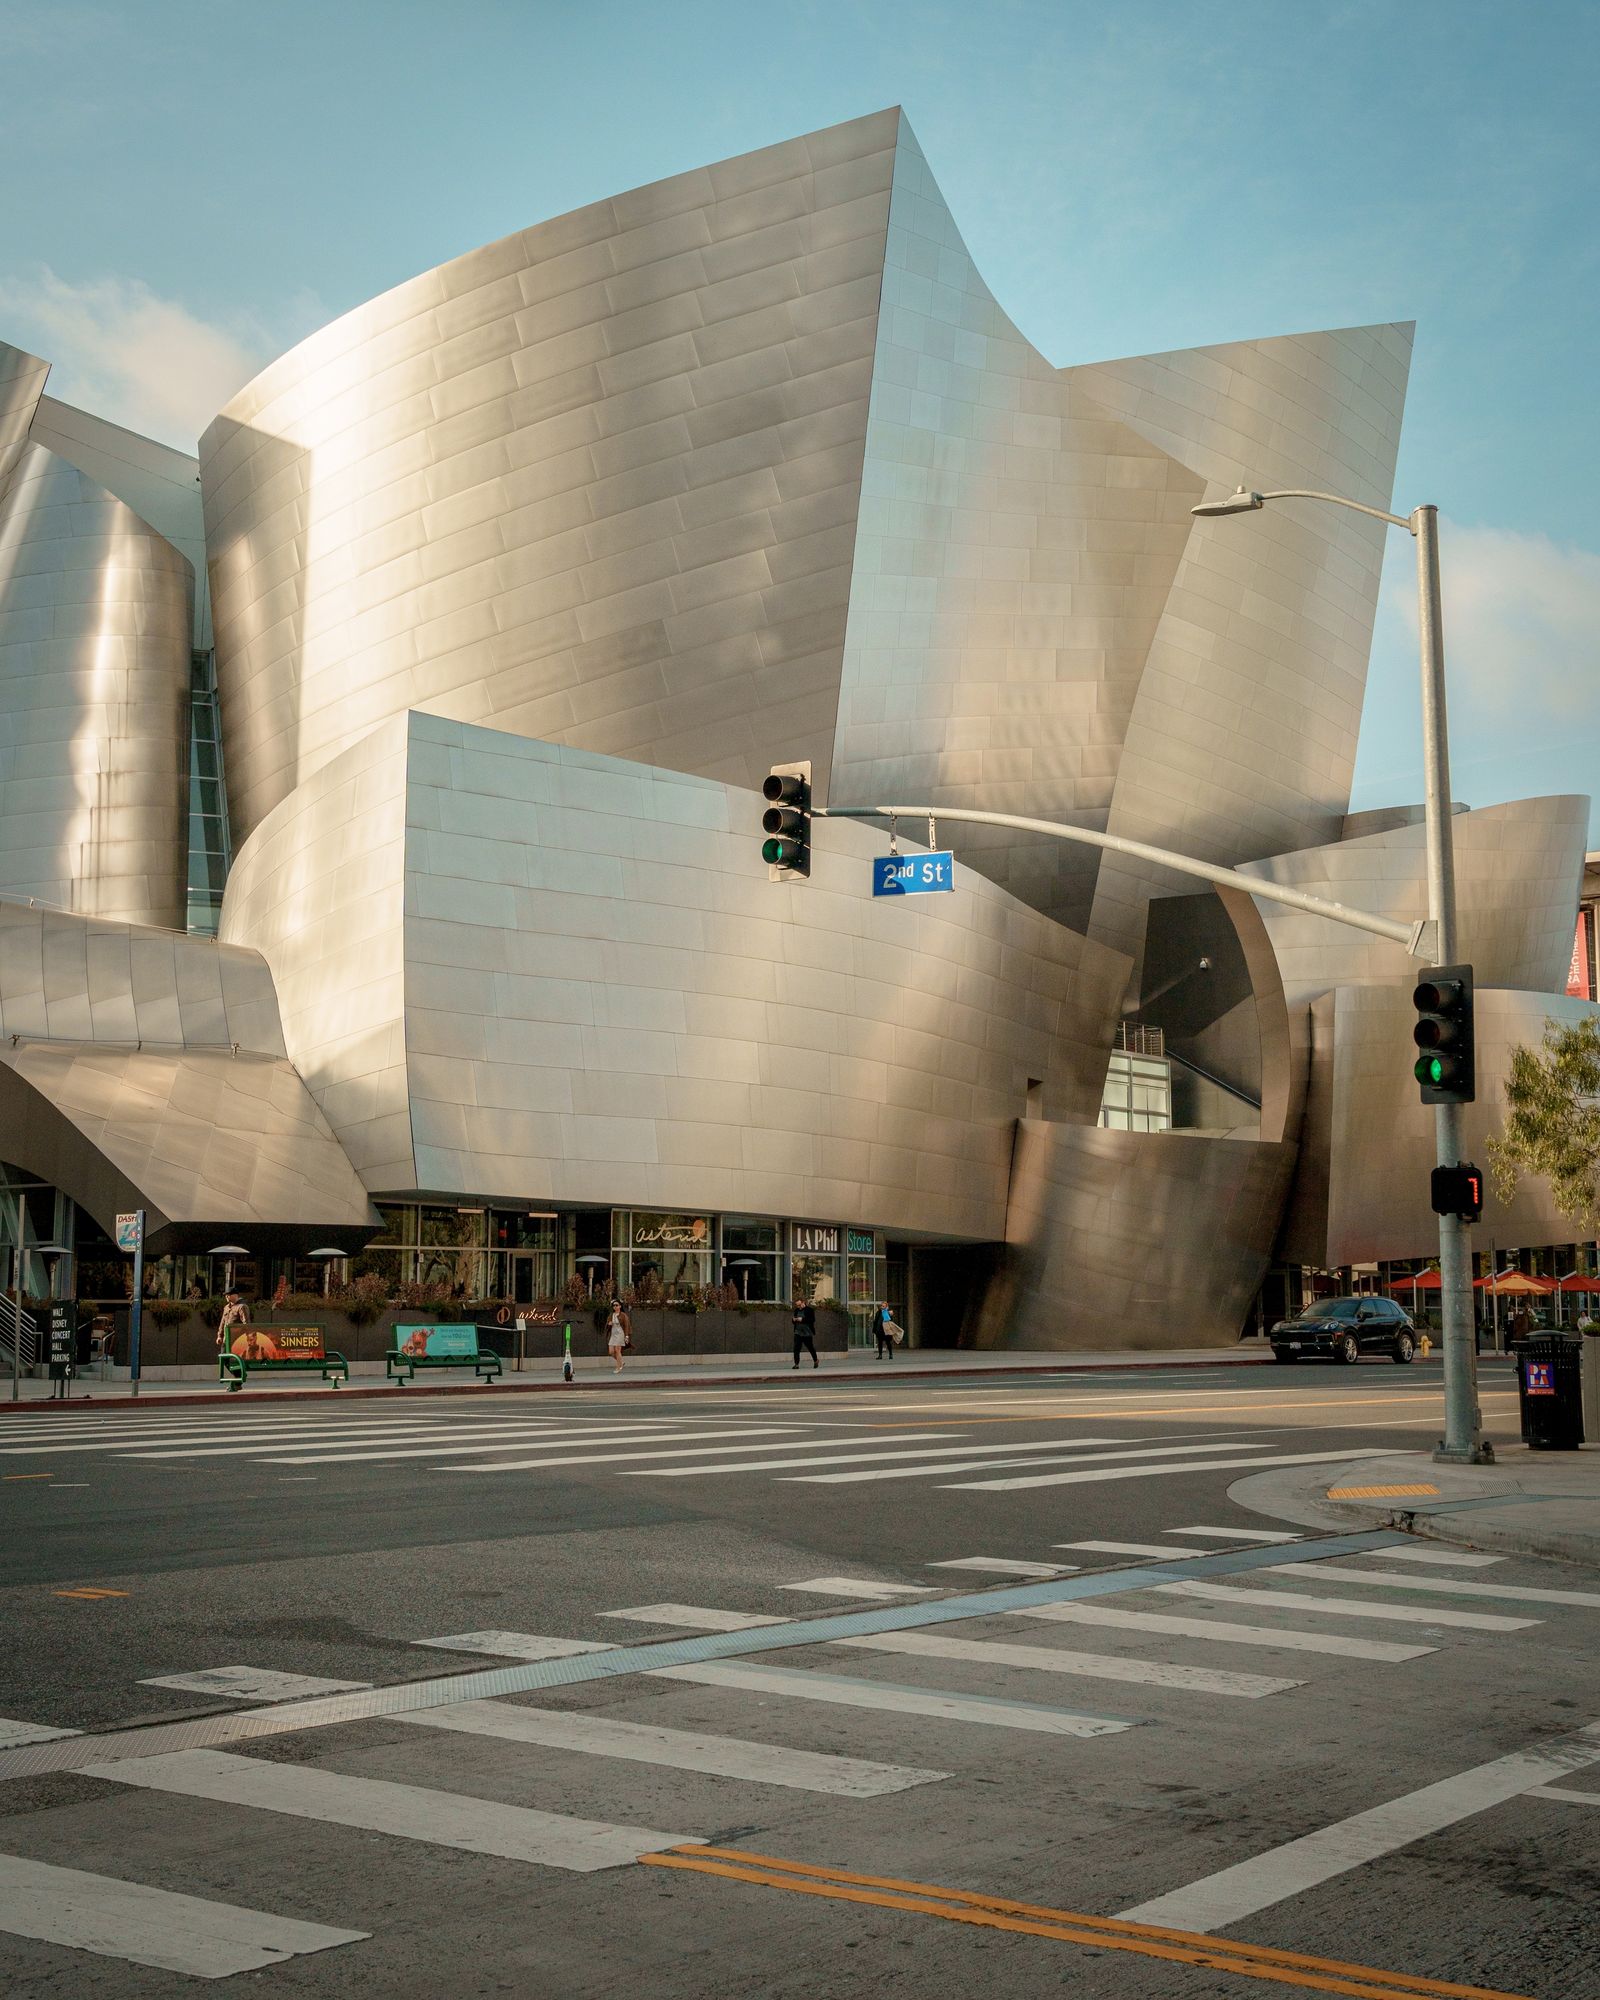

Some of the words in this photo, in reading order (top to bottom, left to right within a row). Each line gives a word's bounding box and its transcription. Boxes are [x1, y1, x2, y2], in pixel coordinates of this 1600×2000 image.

[883, 863, 914, 888] 2nd
[922, 863, 943, 883] St
[797, 1227, 812, 1250] LA
[814, 1228, 838, 1252] Phil
[848, 1230, 872, 1252] Store
[52, 1307, 63, 1316] WALT
[52, 1319, 67, 1328] DISNEY
[52, 1330, 71, 1340] CONCERT
[281, 1336, 319, 1347] SINNERS
[52, 1342, 63, 1351] HALL
[52, 1353, 70, 1362] PARKING
